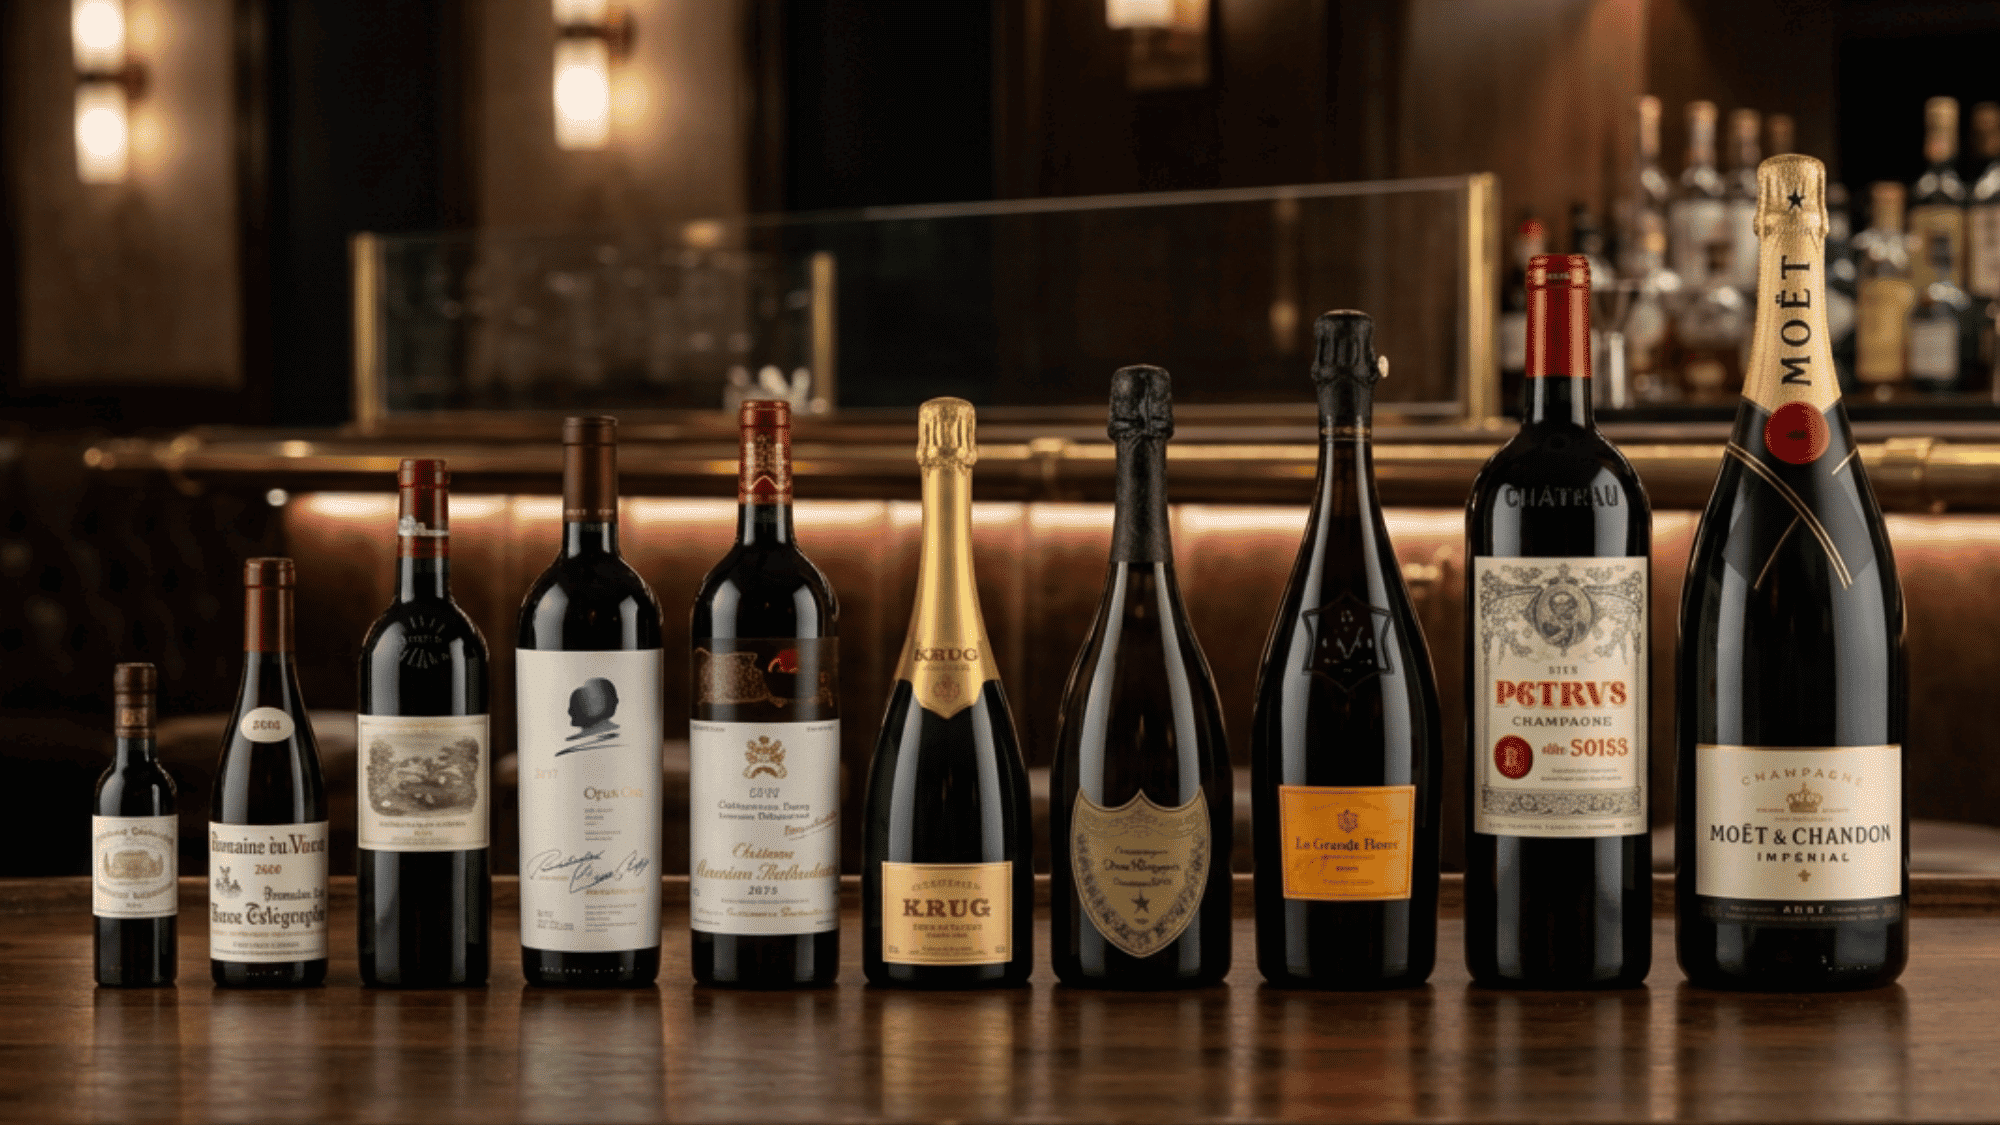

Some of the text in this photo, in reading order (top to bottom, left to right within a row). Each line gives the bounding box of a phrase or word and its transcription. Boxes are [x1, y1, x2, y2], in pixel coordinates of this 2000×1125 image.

[1776, 255, 1812, 386] MOËT
[1773, 828, 1787, 845] &
[1792, 824, 1891, 845] CHANDON
[903, 898, 991, 918] KRUG
